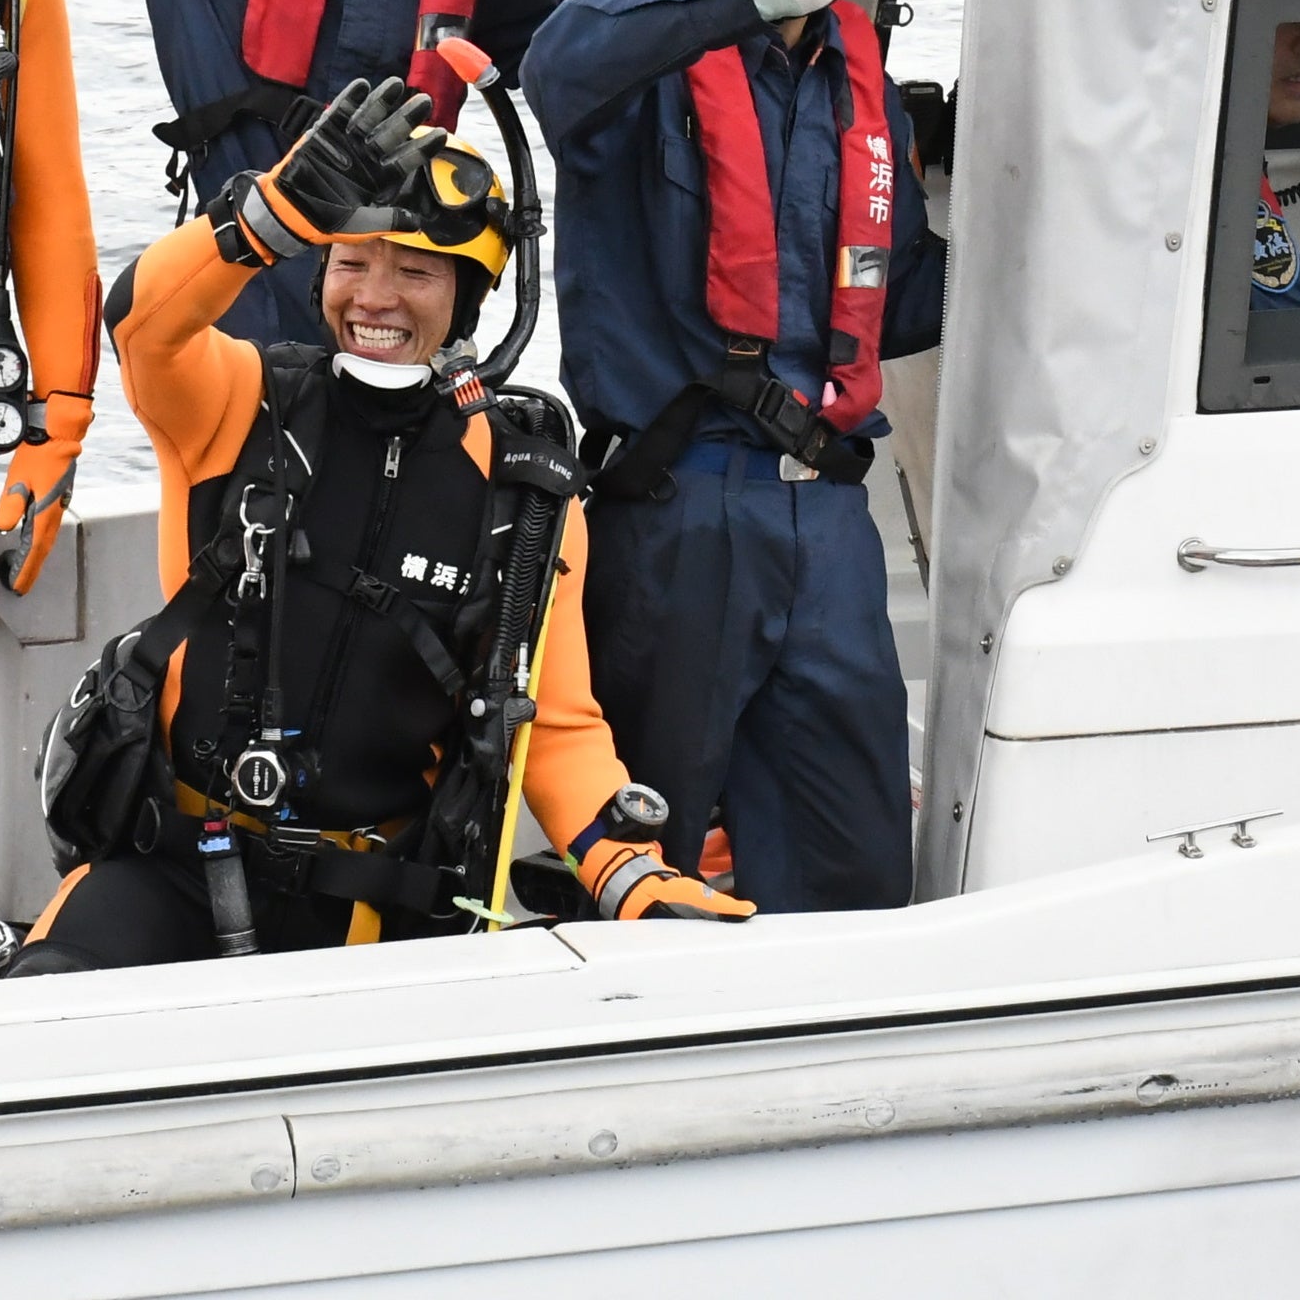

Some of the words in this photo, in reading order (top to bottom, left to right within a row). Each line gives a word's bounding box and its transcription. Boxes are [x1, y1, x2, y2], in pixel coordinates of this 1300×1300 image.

[865, 134, 893, 225] 横浜市
[503, 452, 532, 468] AQUA
[548, 458, 573, 481] LUNG
